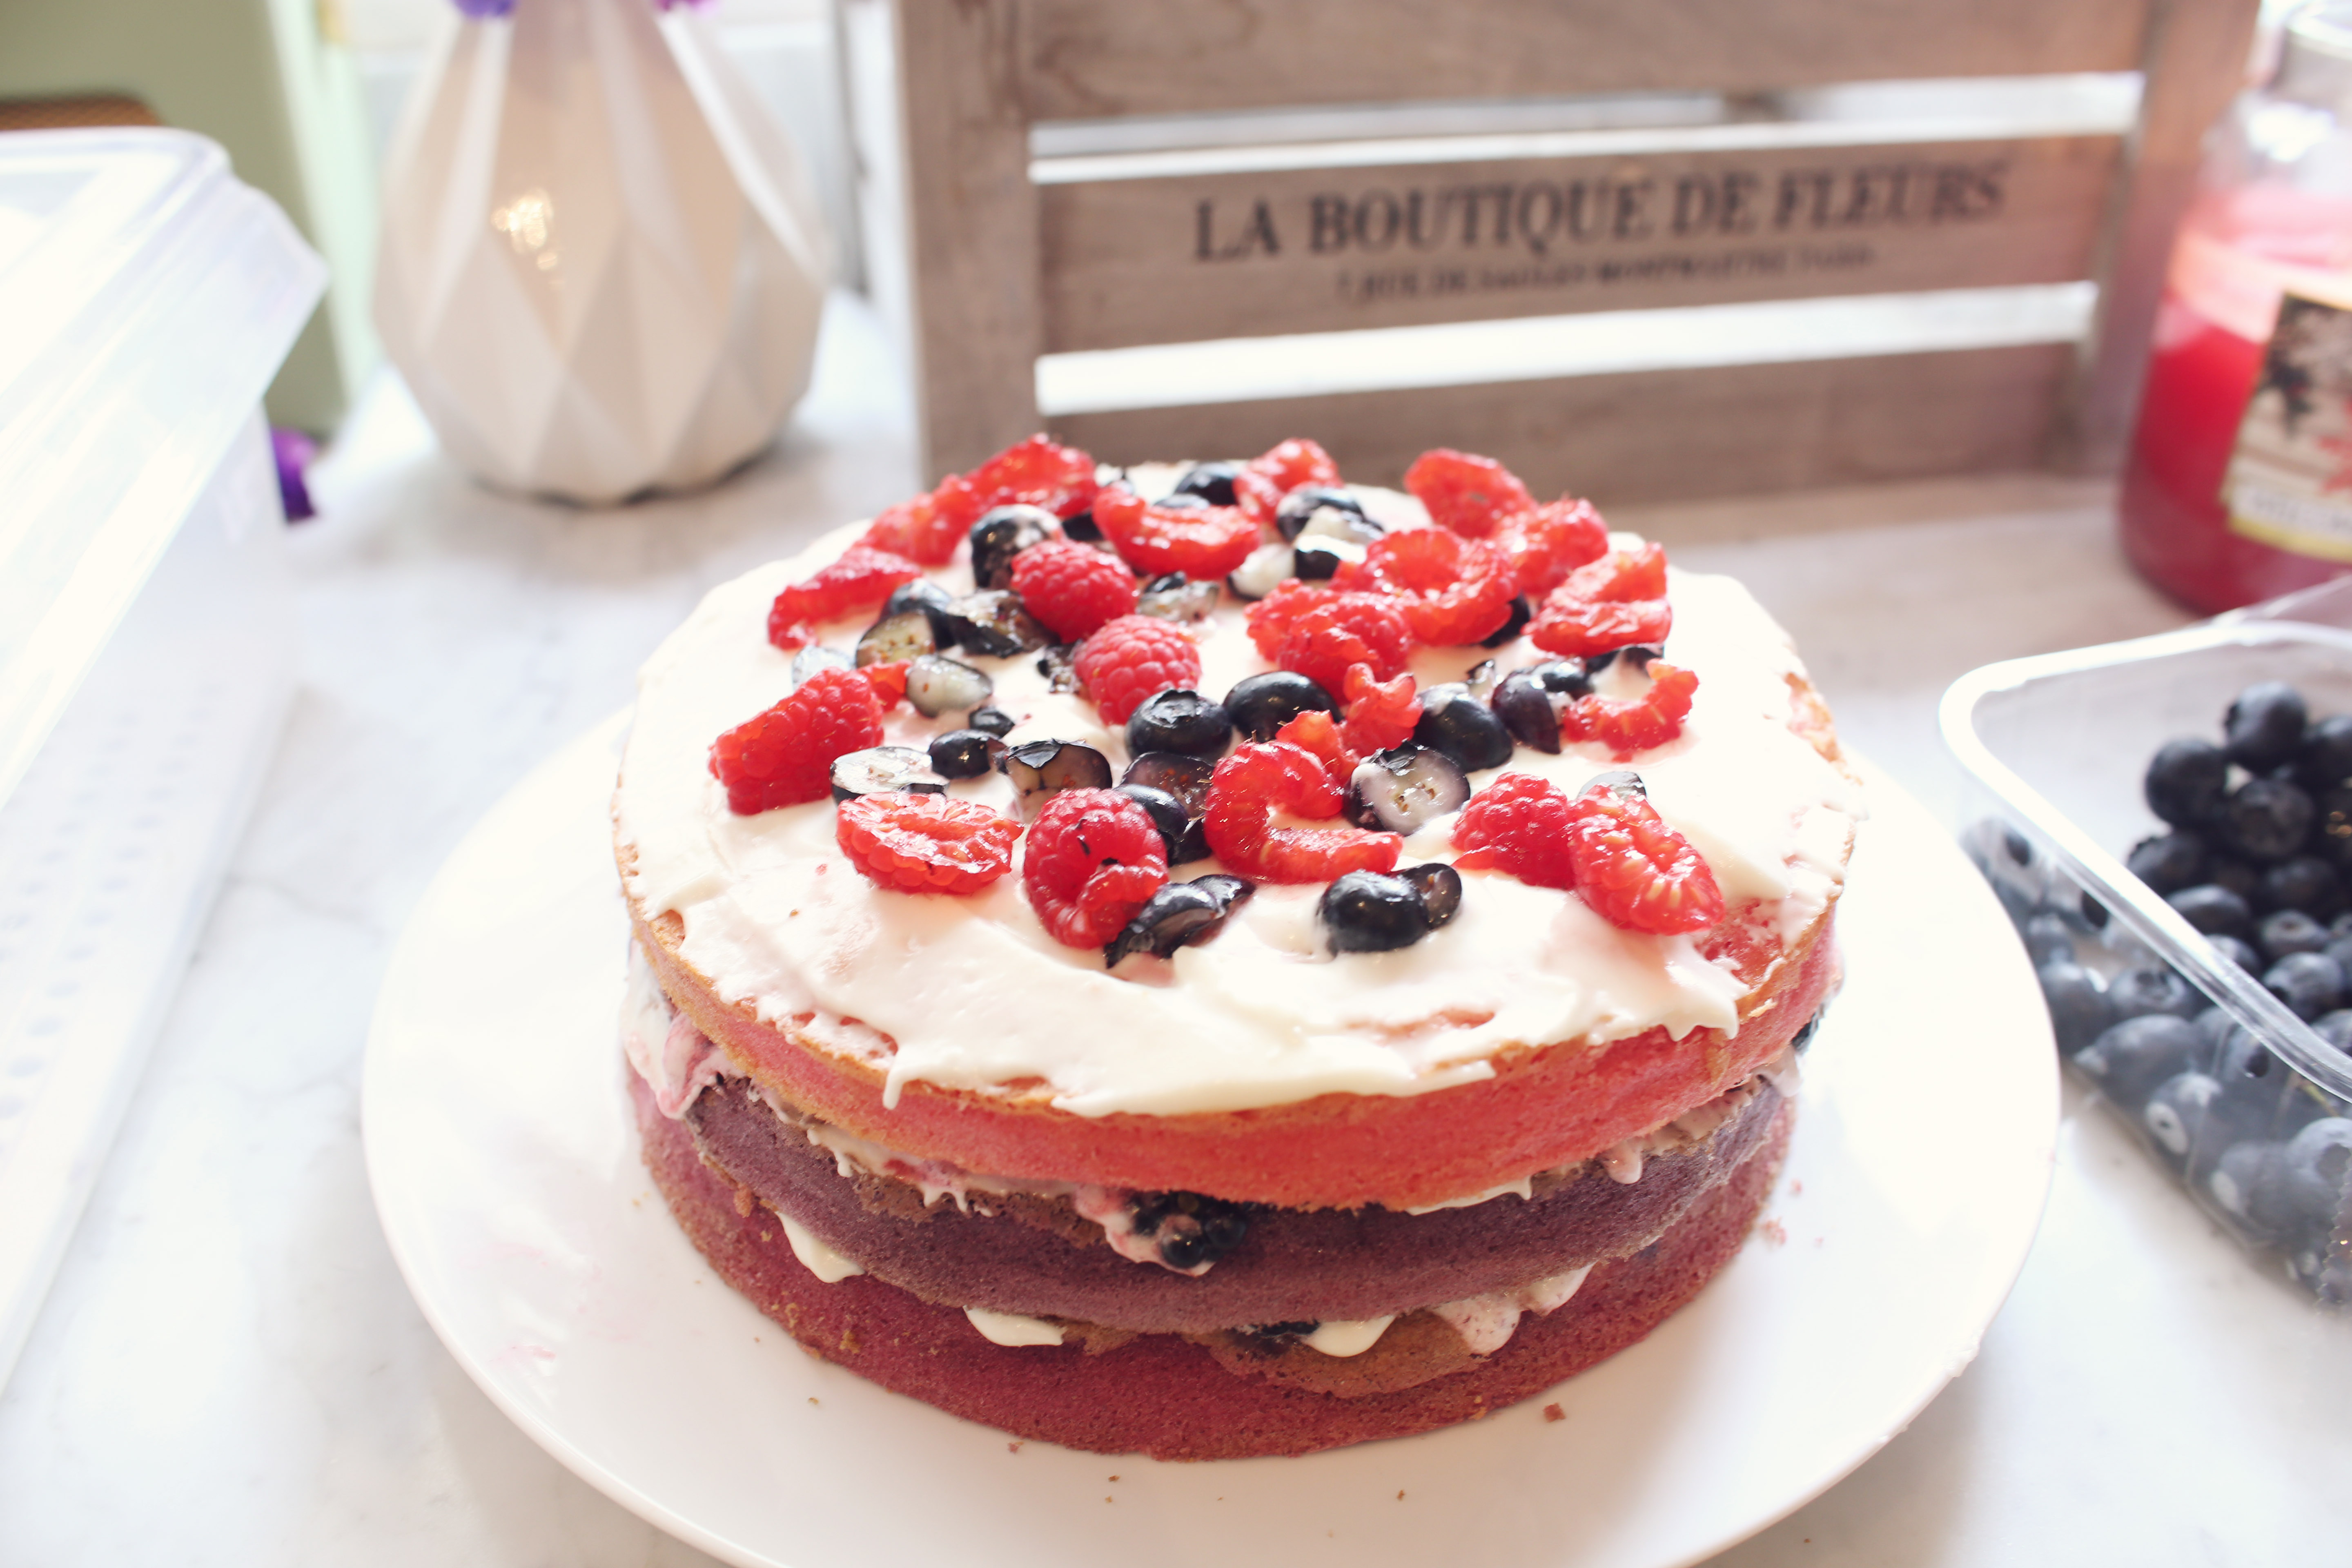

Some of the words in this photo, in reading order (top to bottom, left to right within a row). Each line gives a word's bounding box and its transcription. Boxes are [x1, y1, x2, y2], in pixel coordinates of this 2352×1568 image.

[1194, 197, 1282, 263] LA
[1310, 178, 1658, 257] BOUTIQUE
[1671, 168, 1763, 239] DE
[1773, 162, 2005, 231] FLEURS
